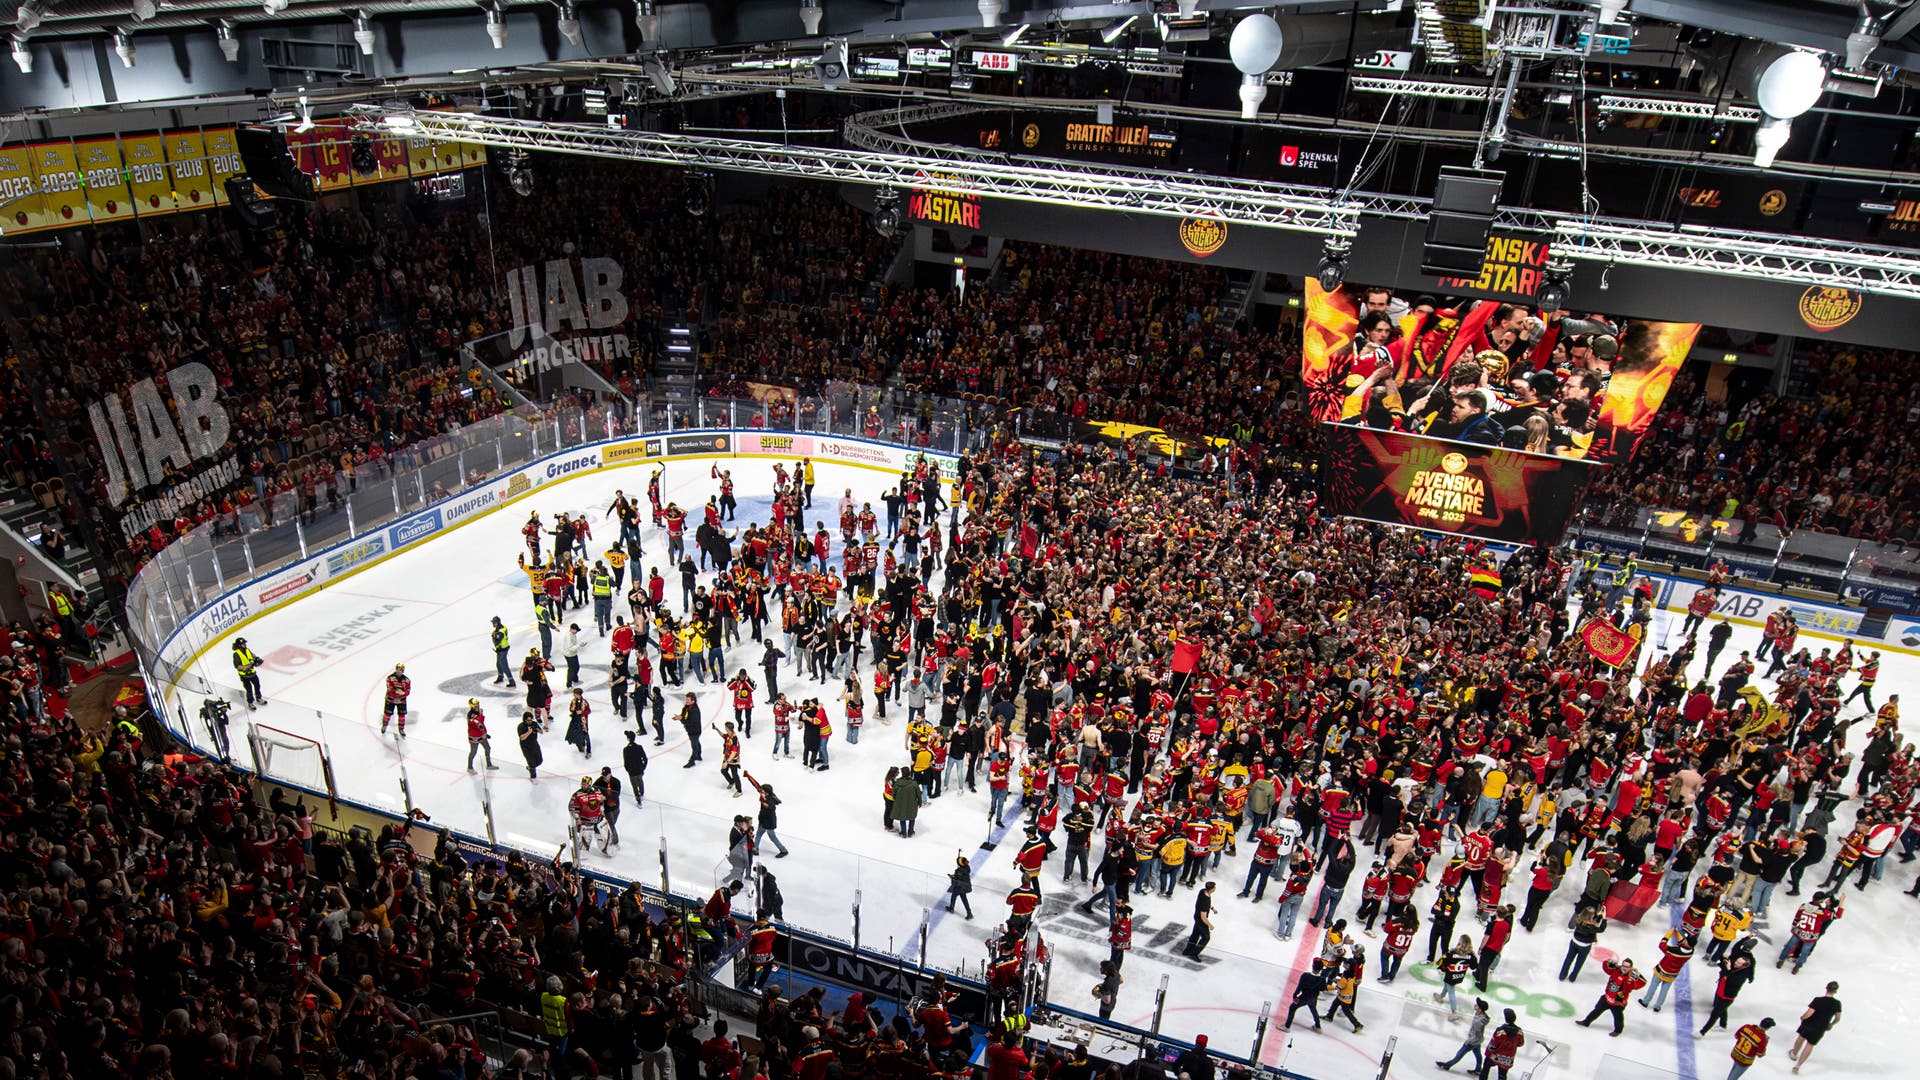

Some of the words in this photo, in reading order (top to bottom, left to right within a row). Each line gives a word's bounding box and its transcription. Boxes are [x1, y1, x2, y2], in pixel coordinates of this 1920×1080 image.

[980, 54, 1009, 69] ABB
[1066, 123, 1113, 143] GRATTIS
[1115, 124, 1149, 146] LULEÅ
[321, 137, 339, 166] 12
[1299, 151, 1339, 163] SVENSKA
[133, 162, 164, 183] 2019
[175, 160, 203, 178] 2018
[213, 154, 240, 174] 2016
[1298, 160, 1319, 169] SPEL
[41, 171, 78, 193] 2022
[88, 167, 121, 188] 2021
[908, 194, 981, 229] MÄSTARE
[506, 256, 629, 351] JIAB
[88, 361, 231, 508] JIAB
[759, 435, 794, 449] SPORT
[608, 446, 644, 459] ZEPPELIN
[646, 443, 661, 454] CAT
[841, 446, 885, 457] NORRBOTTENS
[841, 451, 892, 465] BILDEMONTERING
[546, 454, 597, 479] Granec
[1413, 470, 1485, 497] SVENSKA
[1404, 486, 1484, 516] MÄSTARE
[1442, 510, 1466, 523] 2025
[611, 556, 620, 565] 21
[534, 573, 545, 582] 23
[210, 594, 248, 625] HALA
[307, 602, 402, 648] SVENSKA
[327, 626, 382, 652] SPEL
[1799, 914, 1817, 931] 24
[1396, 934, 1412, 947] 97
[1736, 1036, 1752, 1054] 19
